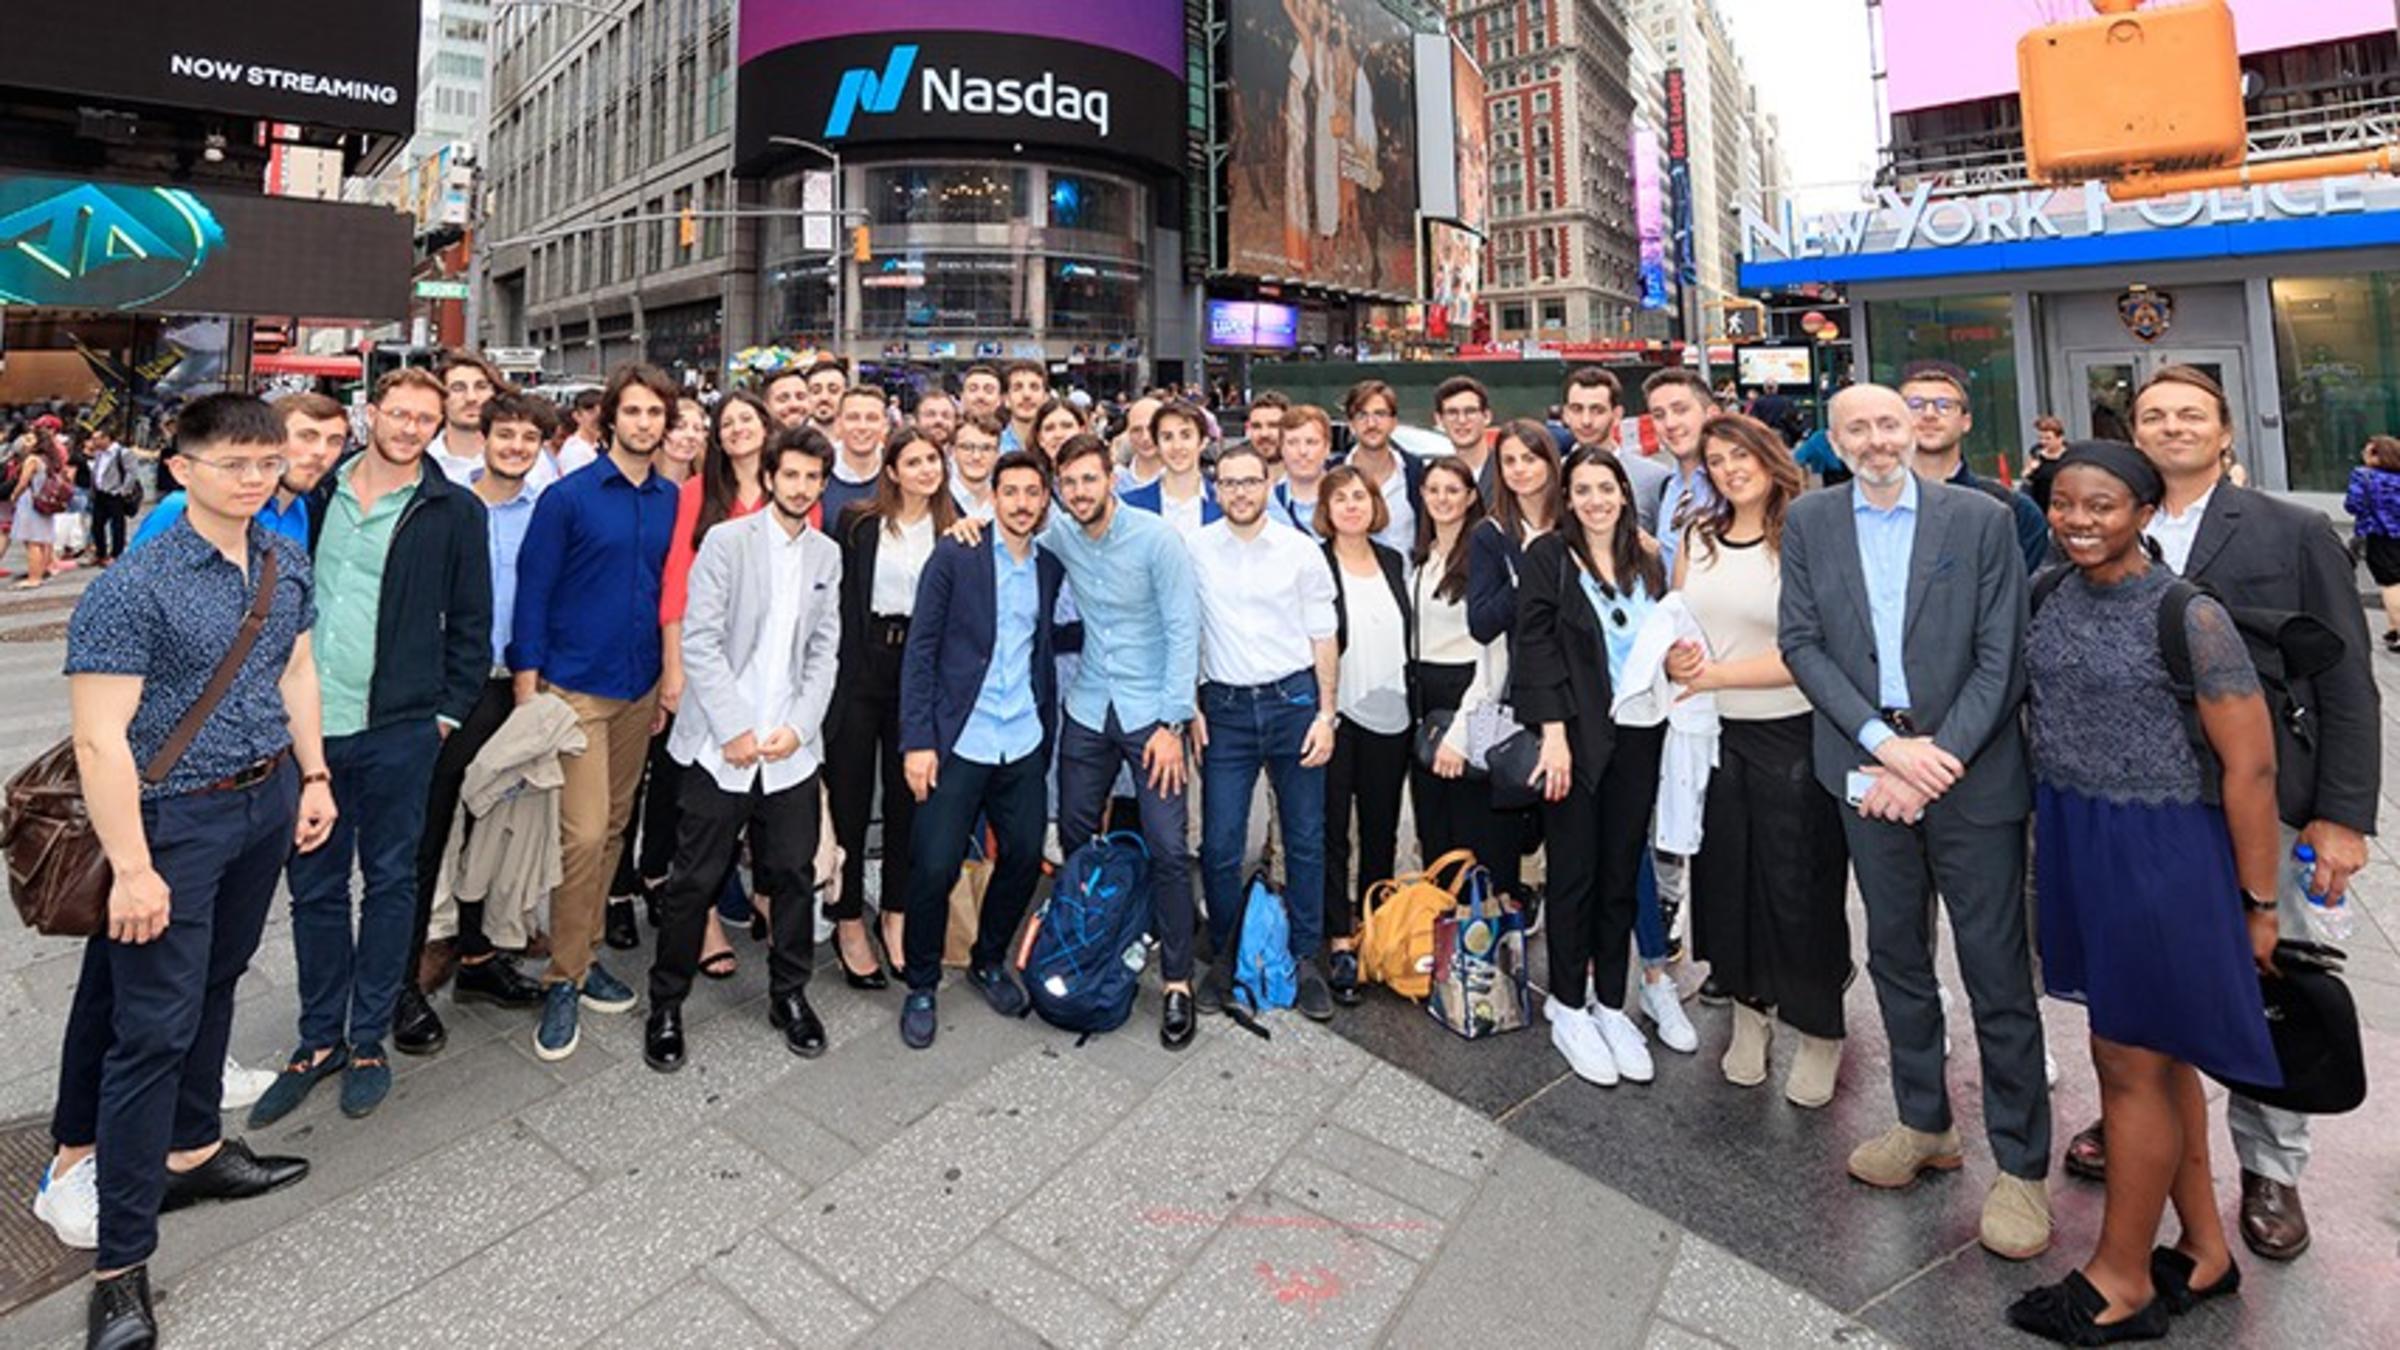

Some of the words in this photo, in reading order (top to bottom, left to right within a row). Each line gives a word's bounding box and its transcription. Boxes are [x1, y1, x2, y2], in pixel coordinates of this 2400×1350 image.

[171, 54, 242, 82] NOW
[247, 66, 397, 104] STREAMING
[922, 67, 1109, 136] Nasdaq
[1874, 181, 2062, 251] YORK
